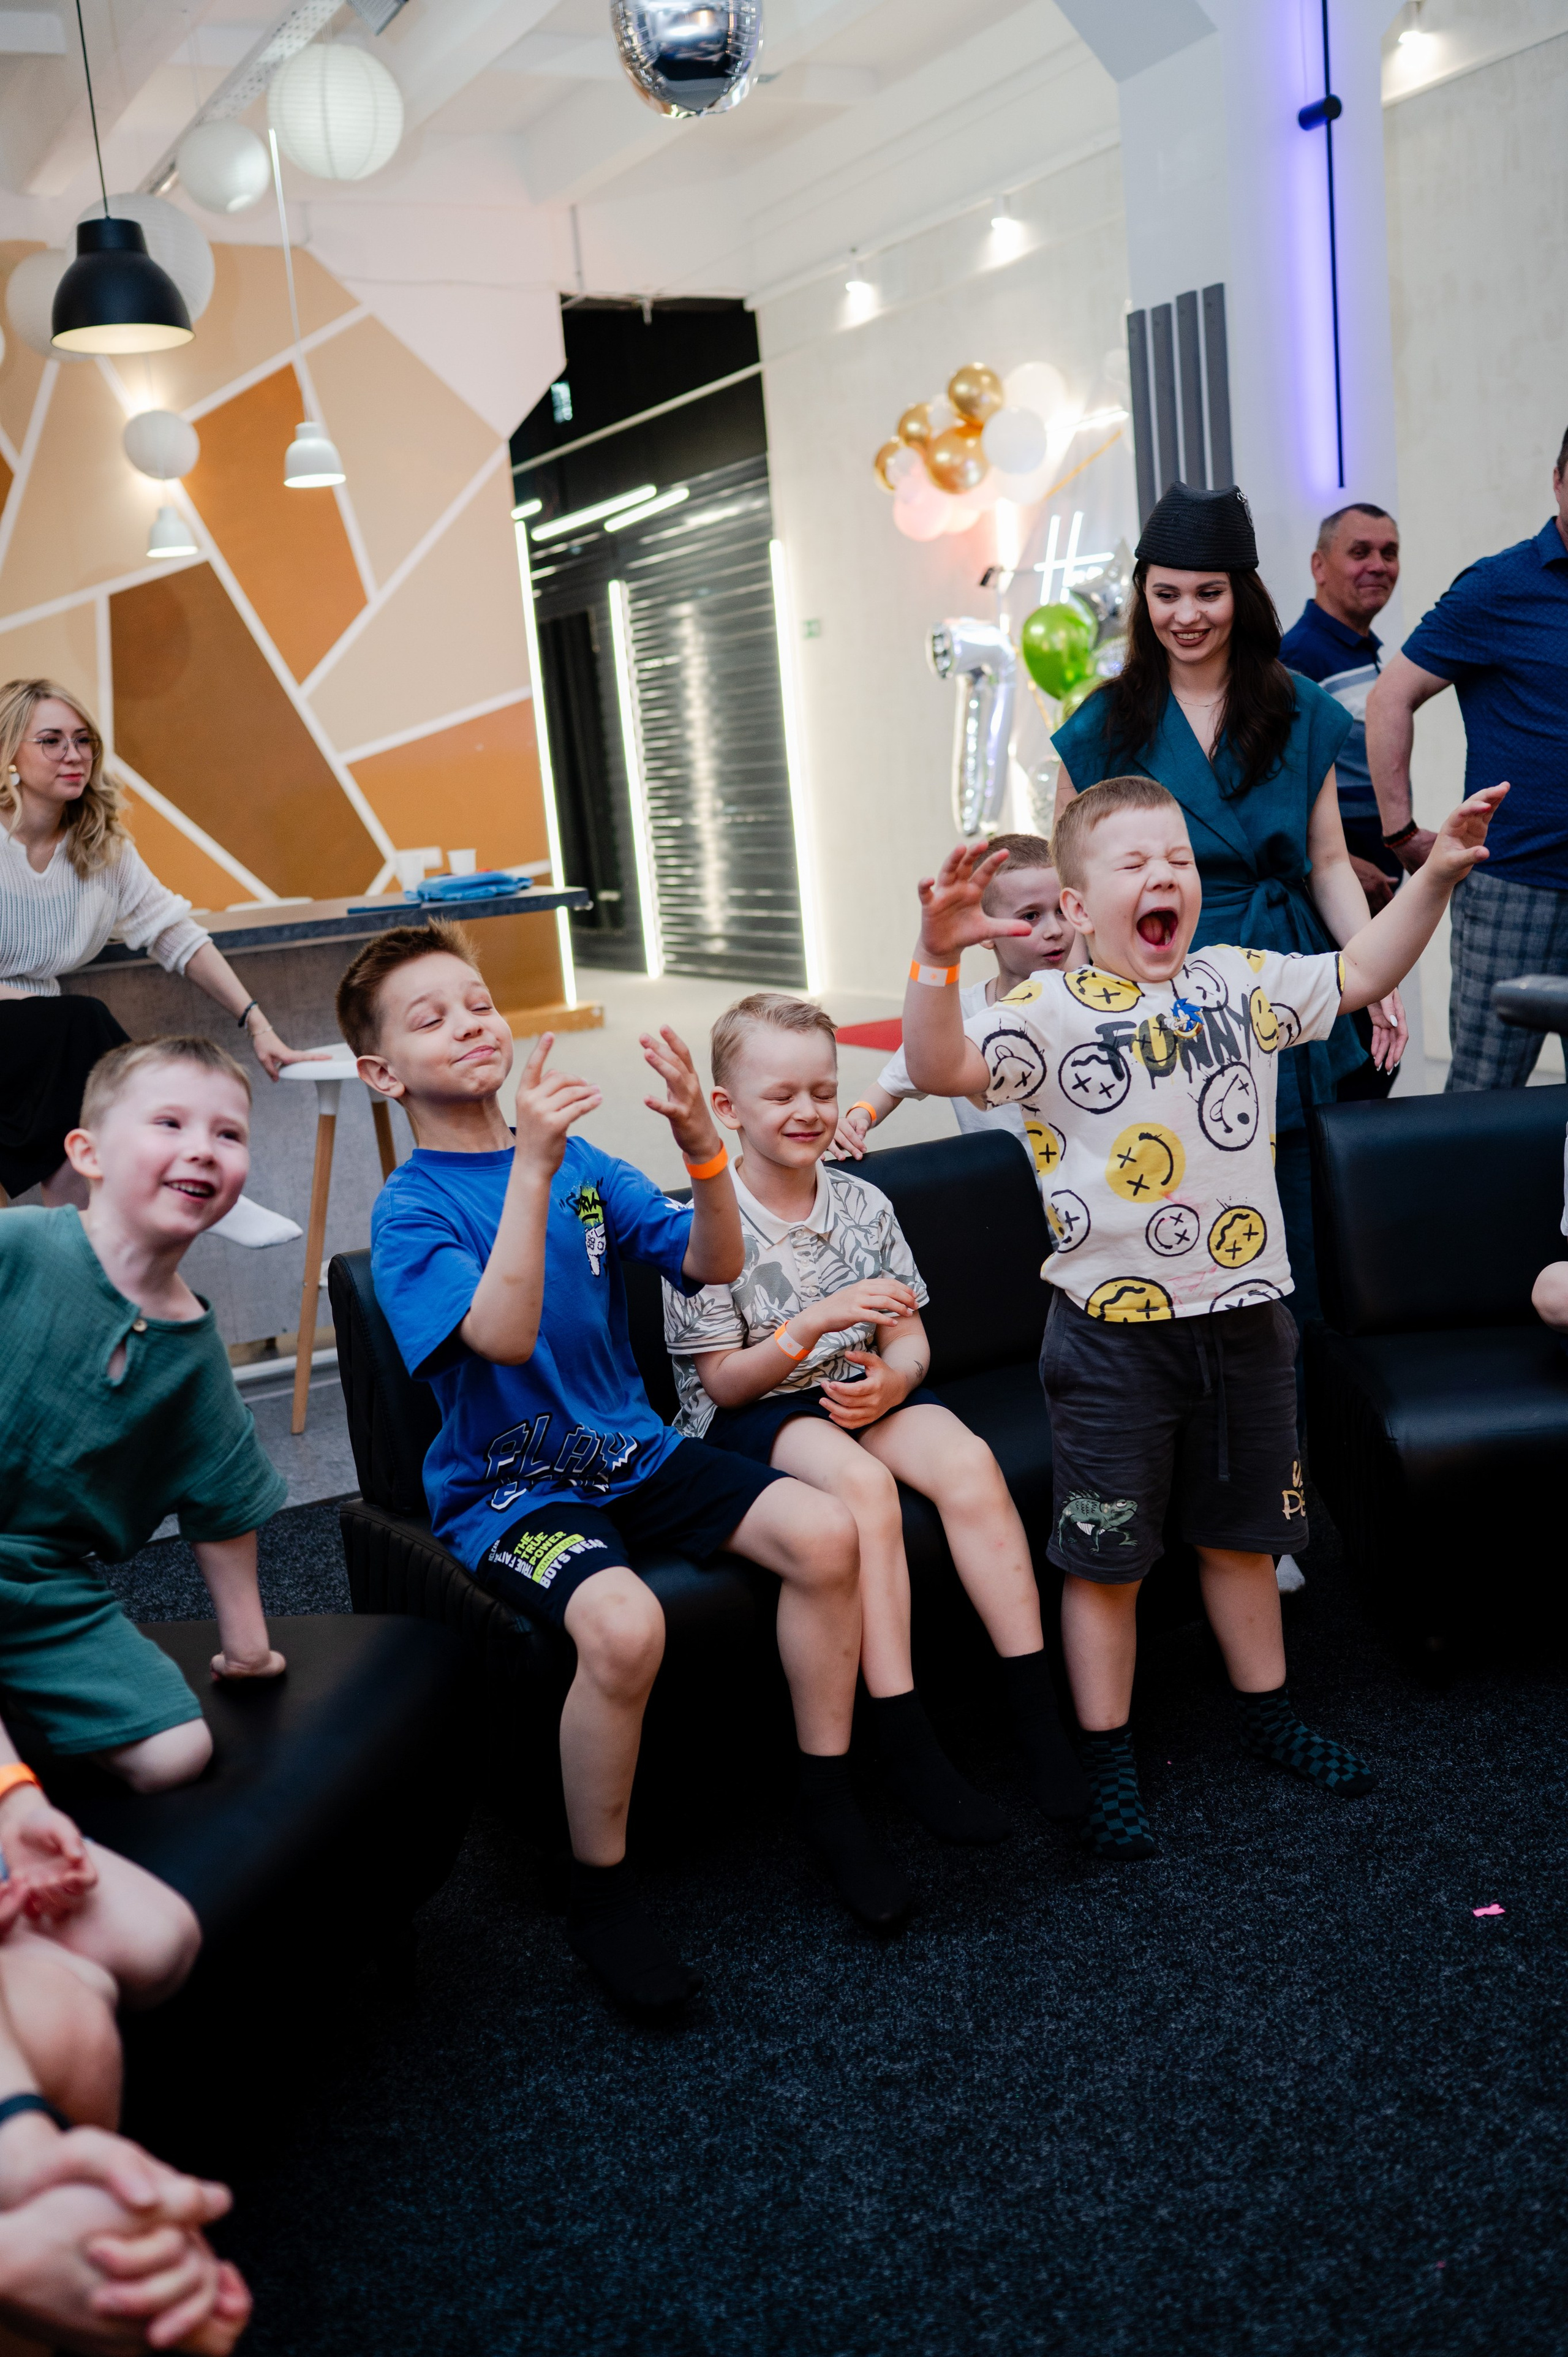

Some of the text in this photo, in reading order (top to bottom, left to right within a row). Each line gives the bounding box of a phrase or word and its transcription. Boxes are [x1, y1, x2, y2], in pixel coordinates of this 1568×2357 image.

[1095, 993, 1252, 1088] FUNNY
[484, 1414, 639, 1480] PLAY
[513, 1531, 534, 1555] THE
[521, 1531, 548, 1559] TRUE
[529, 1531, 567, 1566] POWER
[536, 1536, 576, 1577] CONDITION
[497, 1551, 533, 1579] TRUE FAIT
[539, 1552, 571, 1589] BOYS
